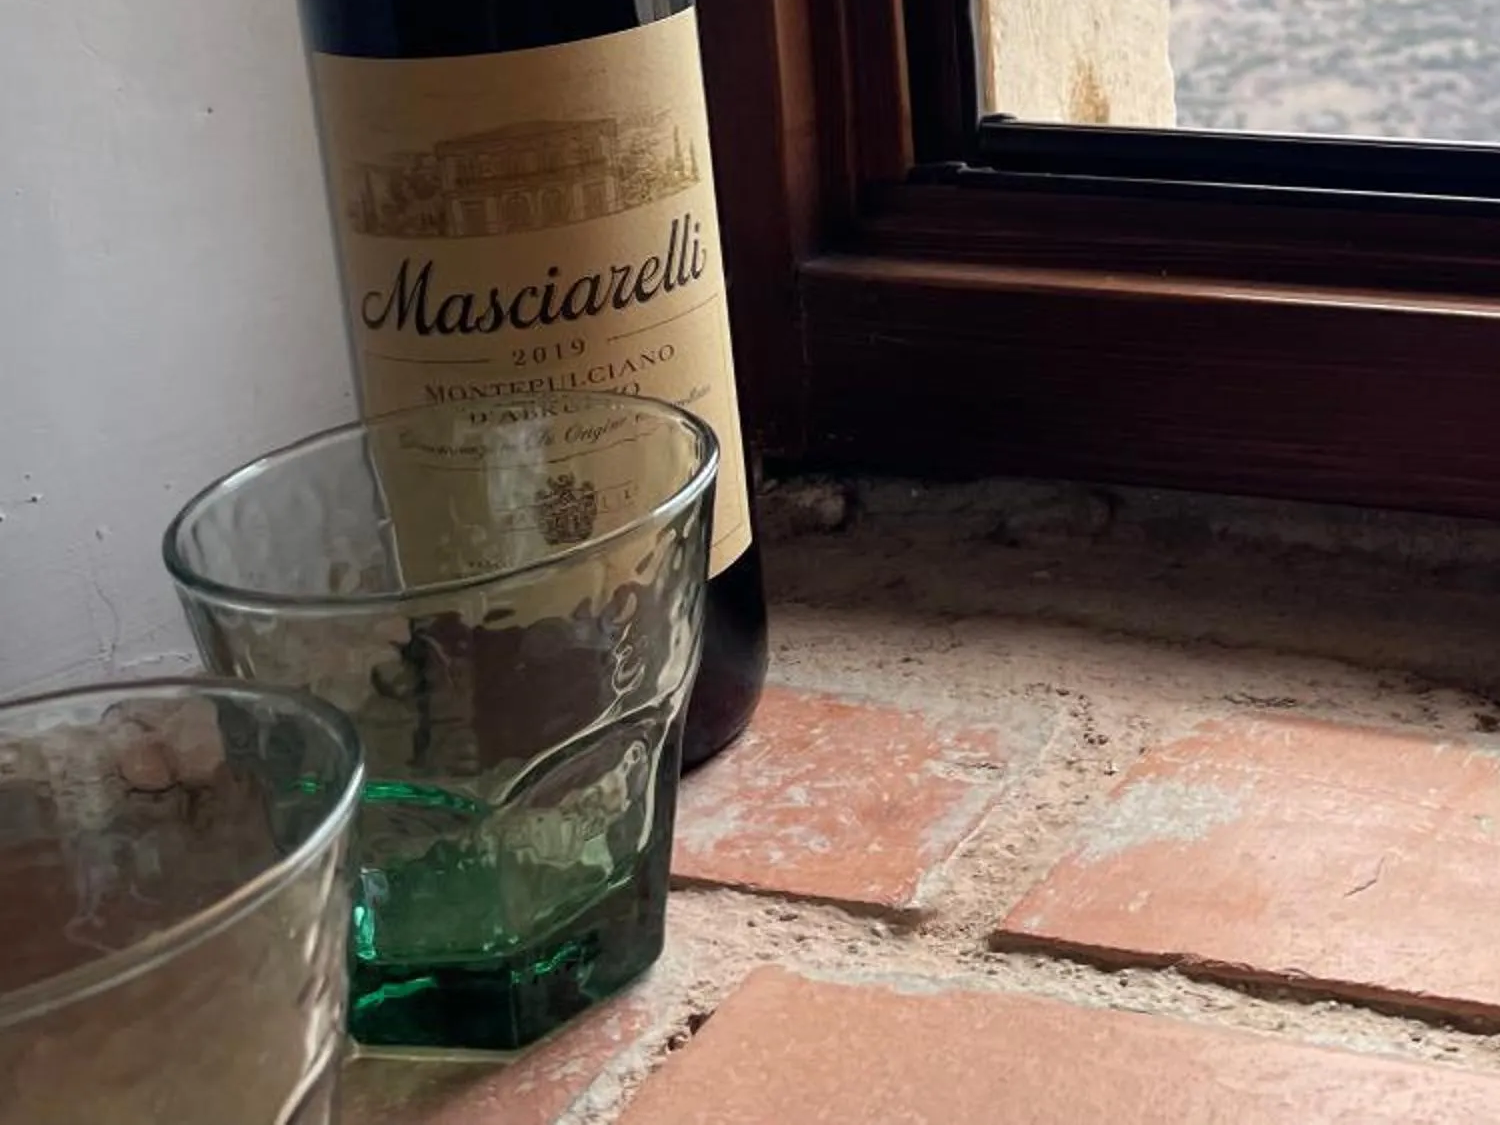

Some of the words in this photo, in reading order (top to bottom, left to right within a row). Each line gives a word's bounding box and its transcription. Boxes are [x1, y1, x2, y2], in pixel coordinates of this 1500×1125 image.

[361, 213, 707, 337] Masciarelli
[424, 343, 675, 405] MONTEPULCIANO
[512, 337, 586, 366] 2019
